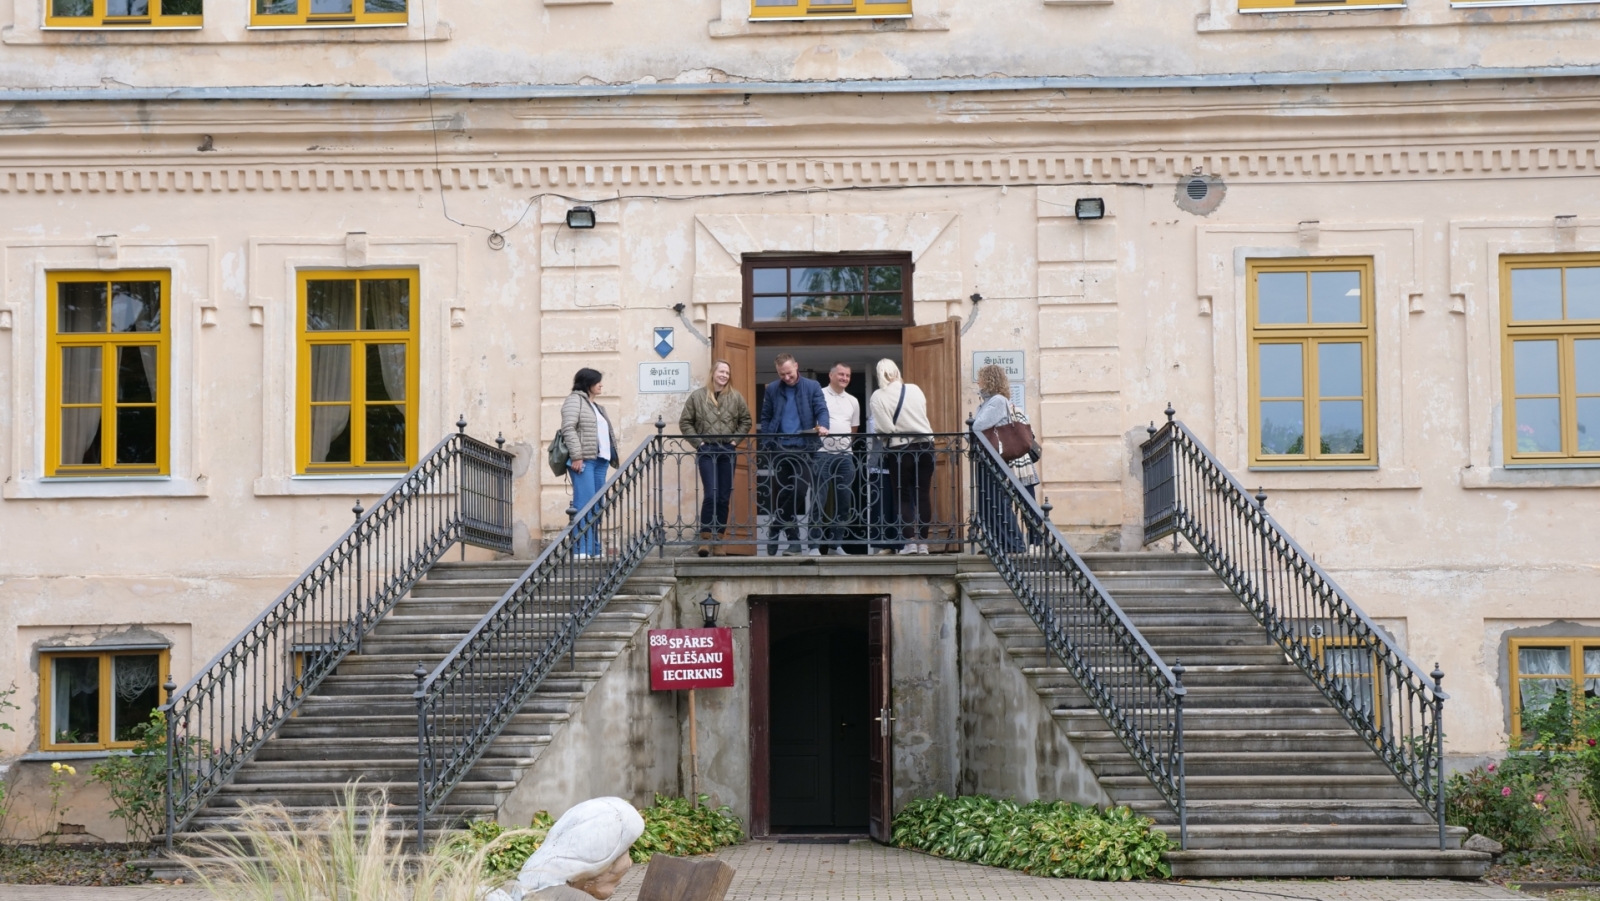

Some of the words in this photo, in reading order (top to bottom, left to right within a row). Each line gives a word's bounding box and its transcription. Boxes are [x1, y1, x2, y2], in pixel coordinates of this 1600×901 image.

[984, 356, 1014, 365] Spāres
[649, 367, 679, 376] Spāres
[653, 377, 676, 387] muiža
[650, 635, 667, 646] 838
[669, 636, 713, 648] SPĀRES
[661, 651, 722, 664] VĒLĒŠANU
[663, 668, 722, 681] IECIRKNIS
